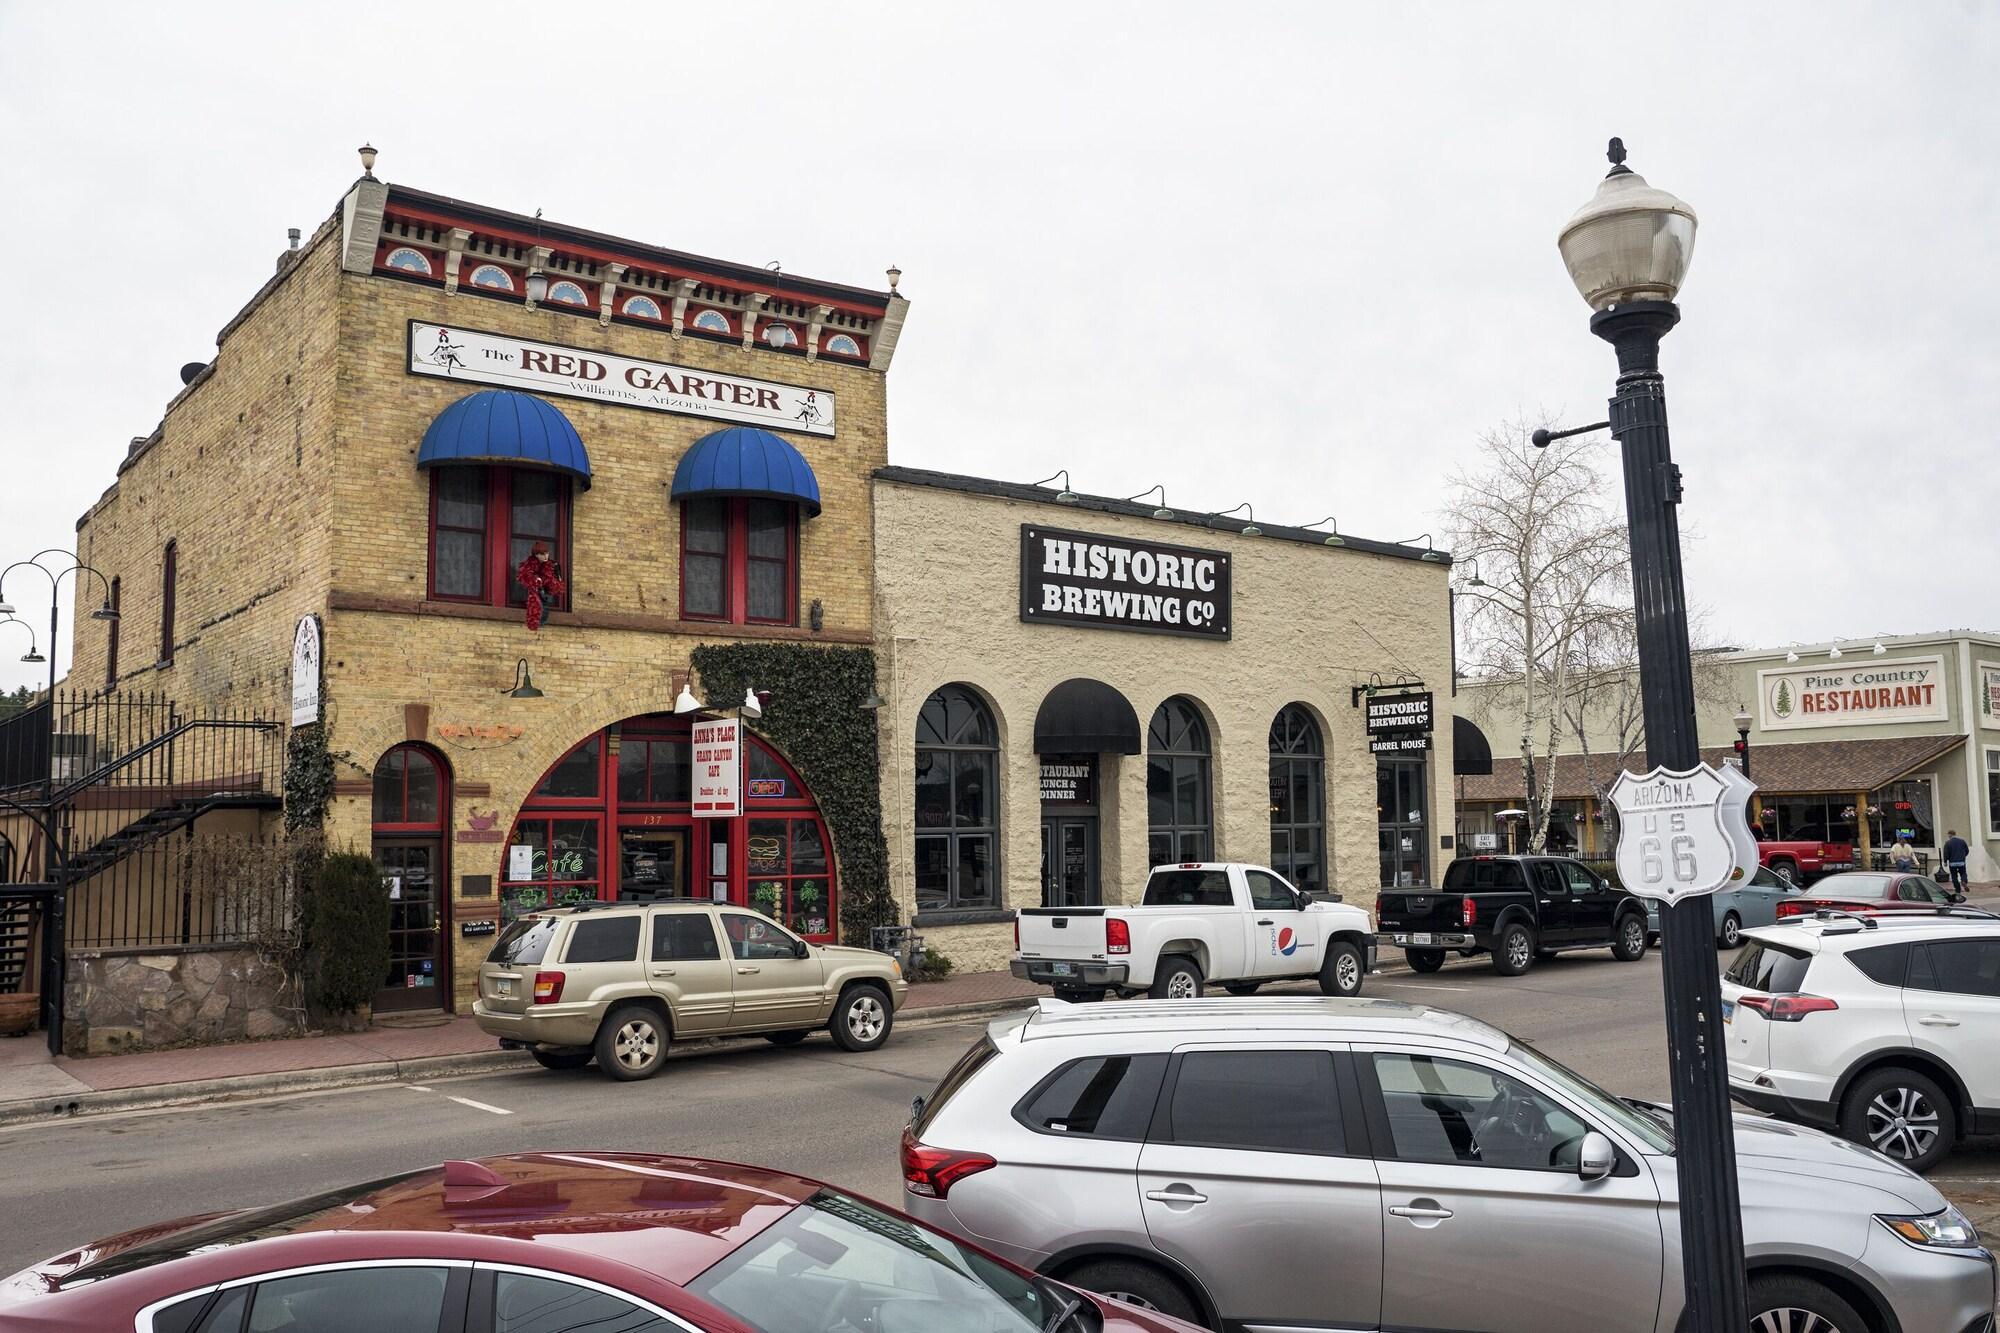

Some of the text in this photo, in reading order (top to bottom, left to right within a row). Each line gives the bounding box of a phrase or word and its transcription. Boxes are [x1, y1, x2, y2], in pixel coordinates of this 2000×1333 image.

[482, 348, 782, 411] The RED GARTER
[648, 395, 707, 411] Arizona
[1043, 538, 1215, 592] HISTORIC
[1042, 583, 1181, 624] BREWING
[1805, 669, 1929, 688] Pine Country
[1802, 685, 1935, 714] RESTAURANT
[1369, 701, 1428, 716] HISTORIC
[1369, 715, 1415, 727] BREWING
[694, 726, 735, 744] ANNA'S PLACE
[1372, 740, 1426, 751] BARREL HOUSE
[696, 748, 732, 762] GRAND CANYON
[708, 765, 720, 777] CAFE
[1040, 765, 1090, 777] STAURANT
[751, 782, 783, 794] OPEN
[1040, 790, 1075, 799] DINNER
[1634, 782, 1695, 806] ARIZONA
[644, 815, 662, 825] 137
[530, 850, 584, 873] Café
[748, 859, 787, 872] urgers
[1639, 834, 1698, 883] 66
